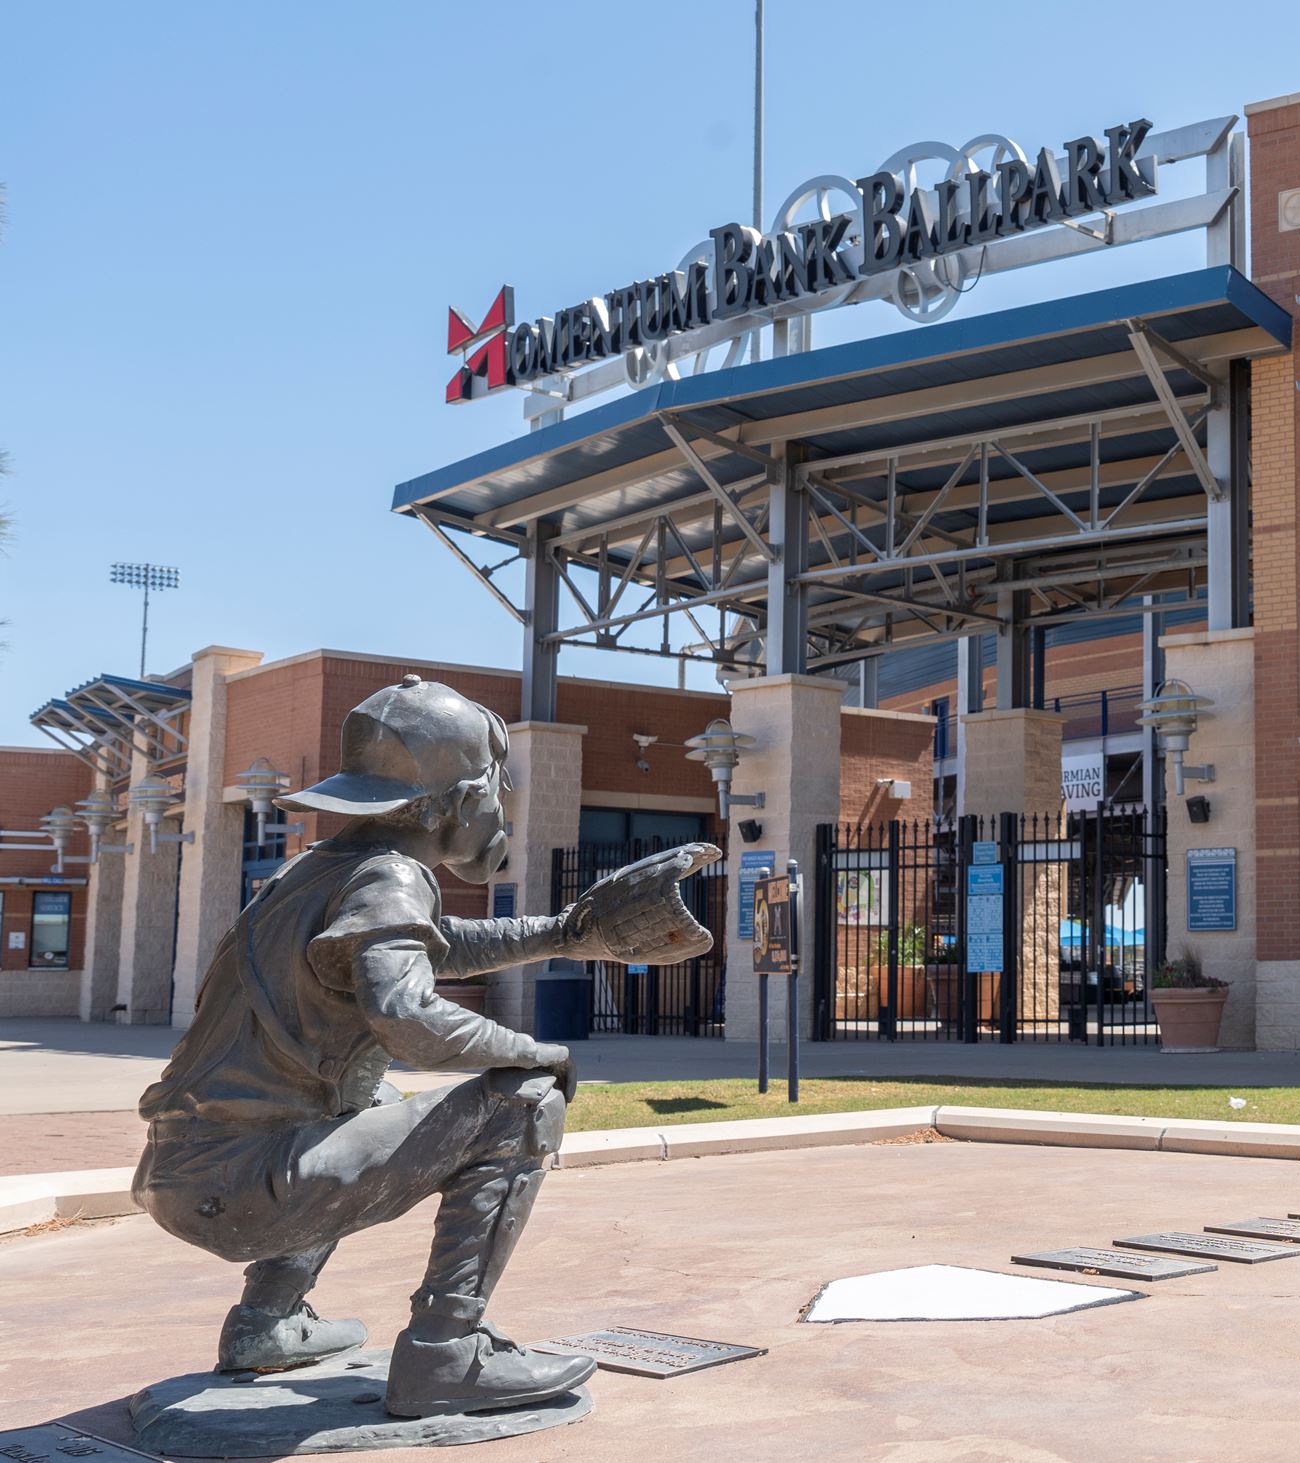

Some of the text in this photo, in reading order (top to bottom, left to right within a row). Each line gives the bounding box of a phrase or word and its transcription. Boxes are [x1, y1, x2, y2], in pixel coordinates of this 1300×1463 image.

[445, 117, 1157, 403] MOMENTUM BANK BALLPARK
